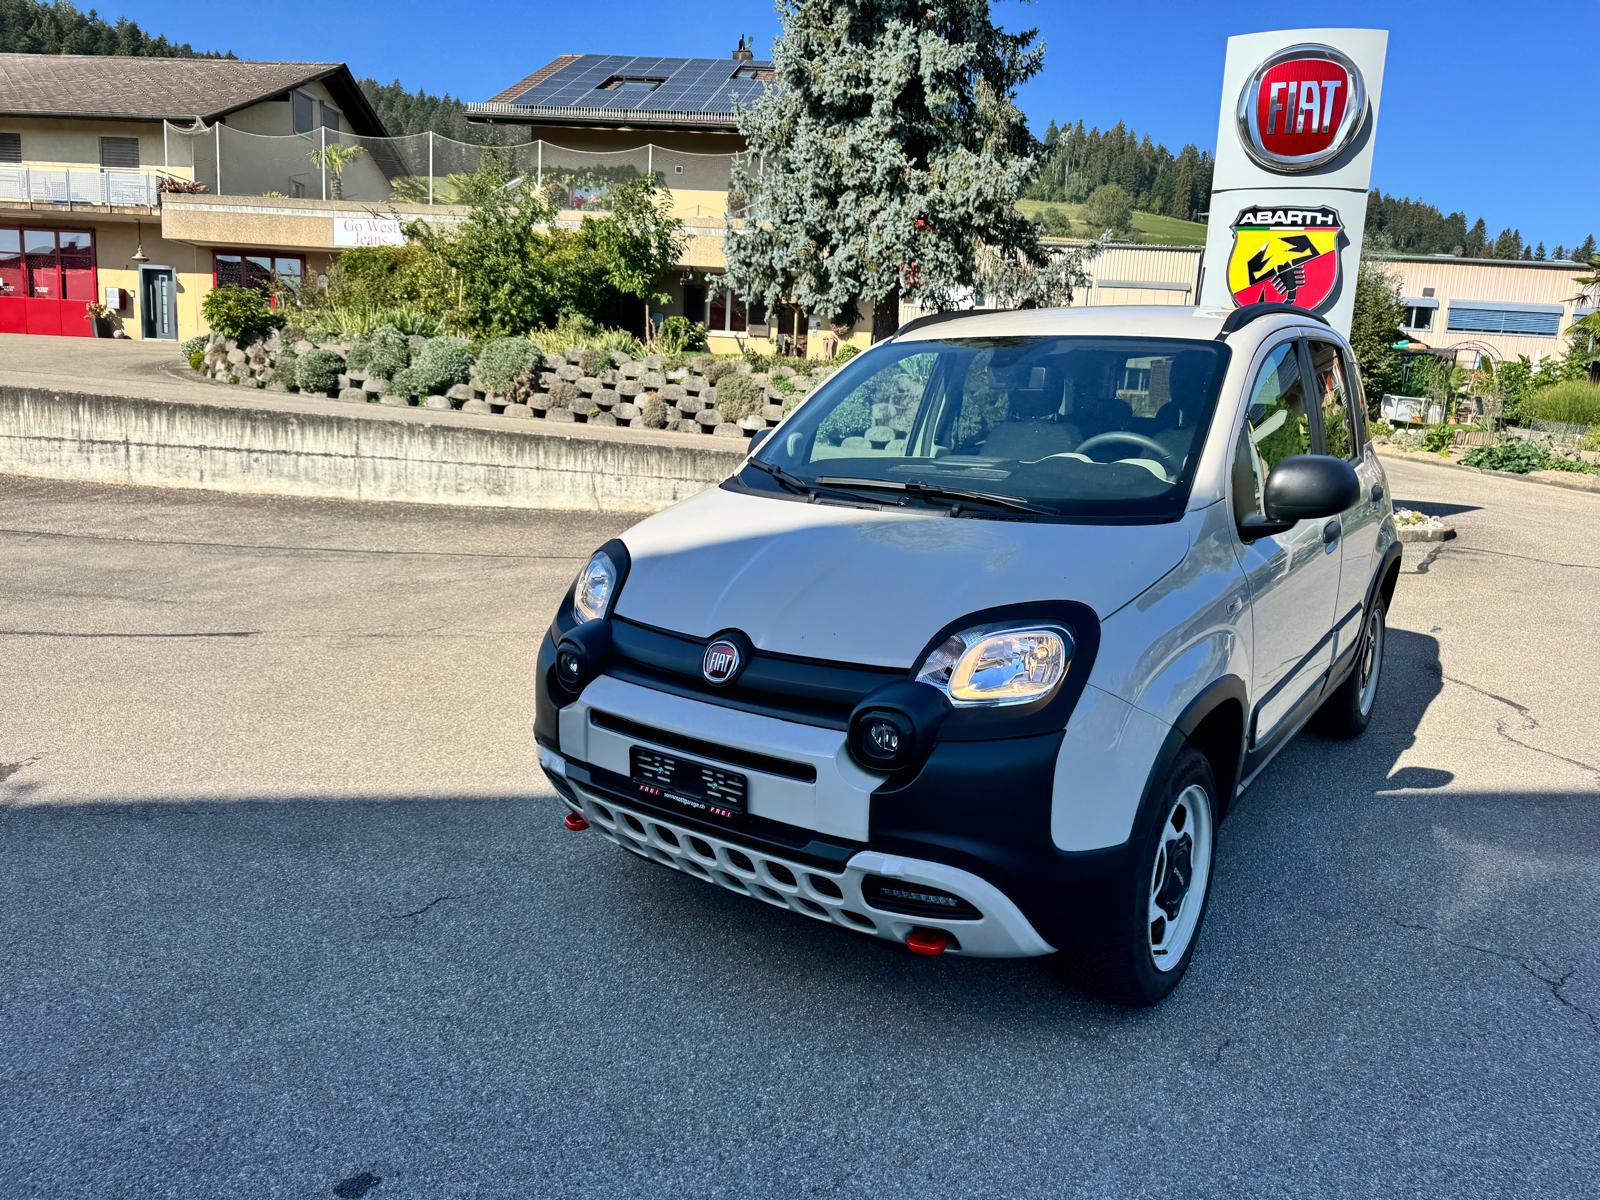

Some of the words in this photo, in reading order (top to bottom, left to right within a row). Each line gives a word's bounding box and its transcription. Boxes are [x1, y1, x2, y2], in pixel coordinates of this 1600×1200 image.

[1268, 81, 1342, 134] FIAT
[1239, 211, 1333, 225] ABARTH
[343, 219, 362, 232] Go
[367, 220, 397, 233] West
[709, 652, 732, 672] FIAT
[709, 806, 733, 818] FREI
